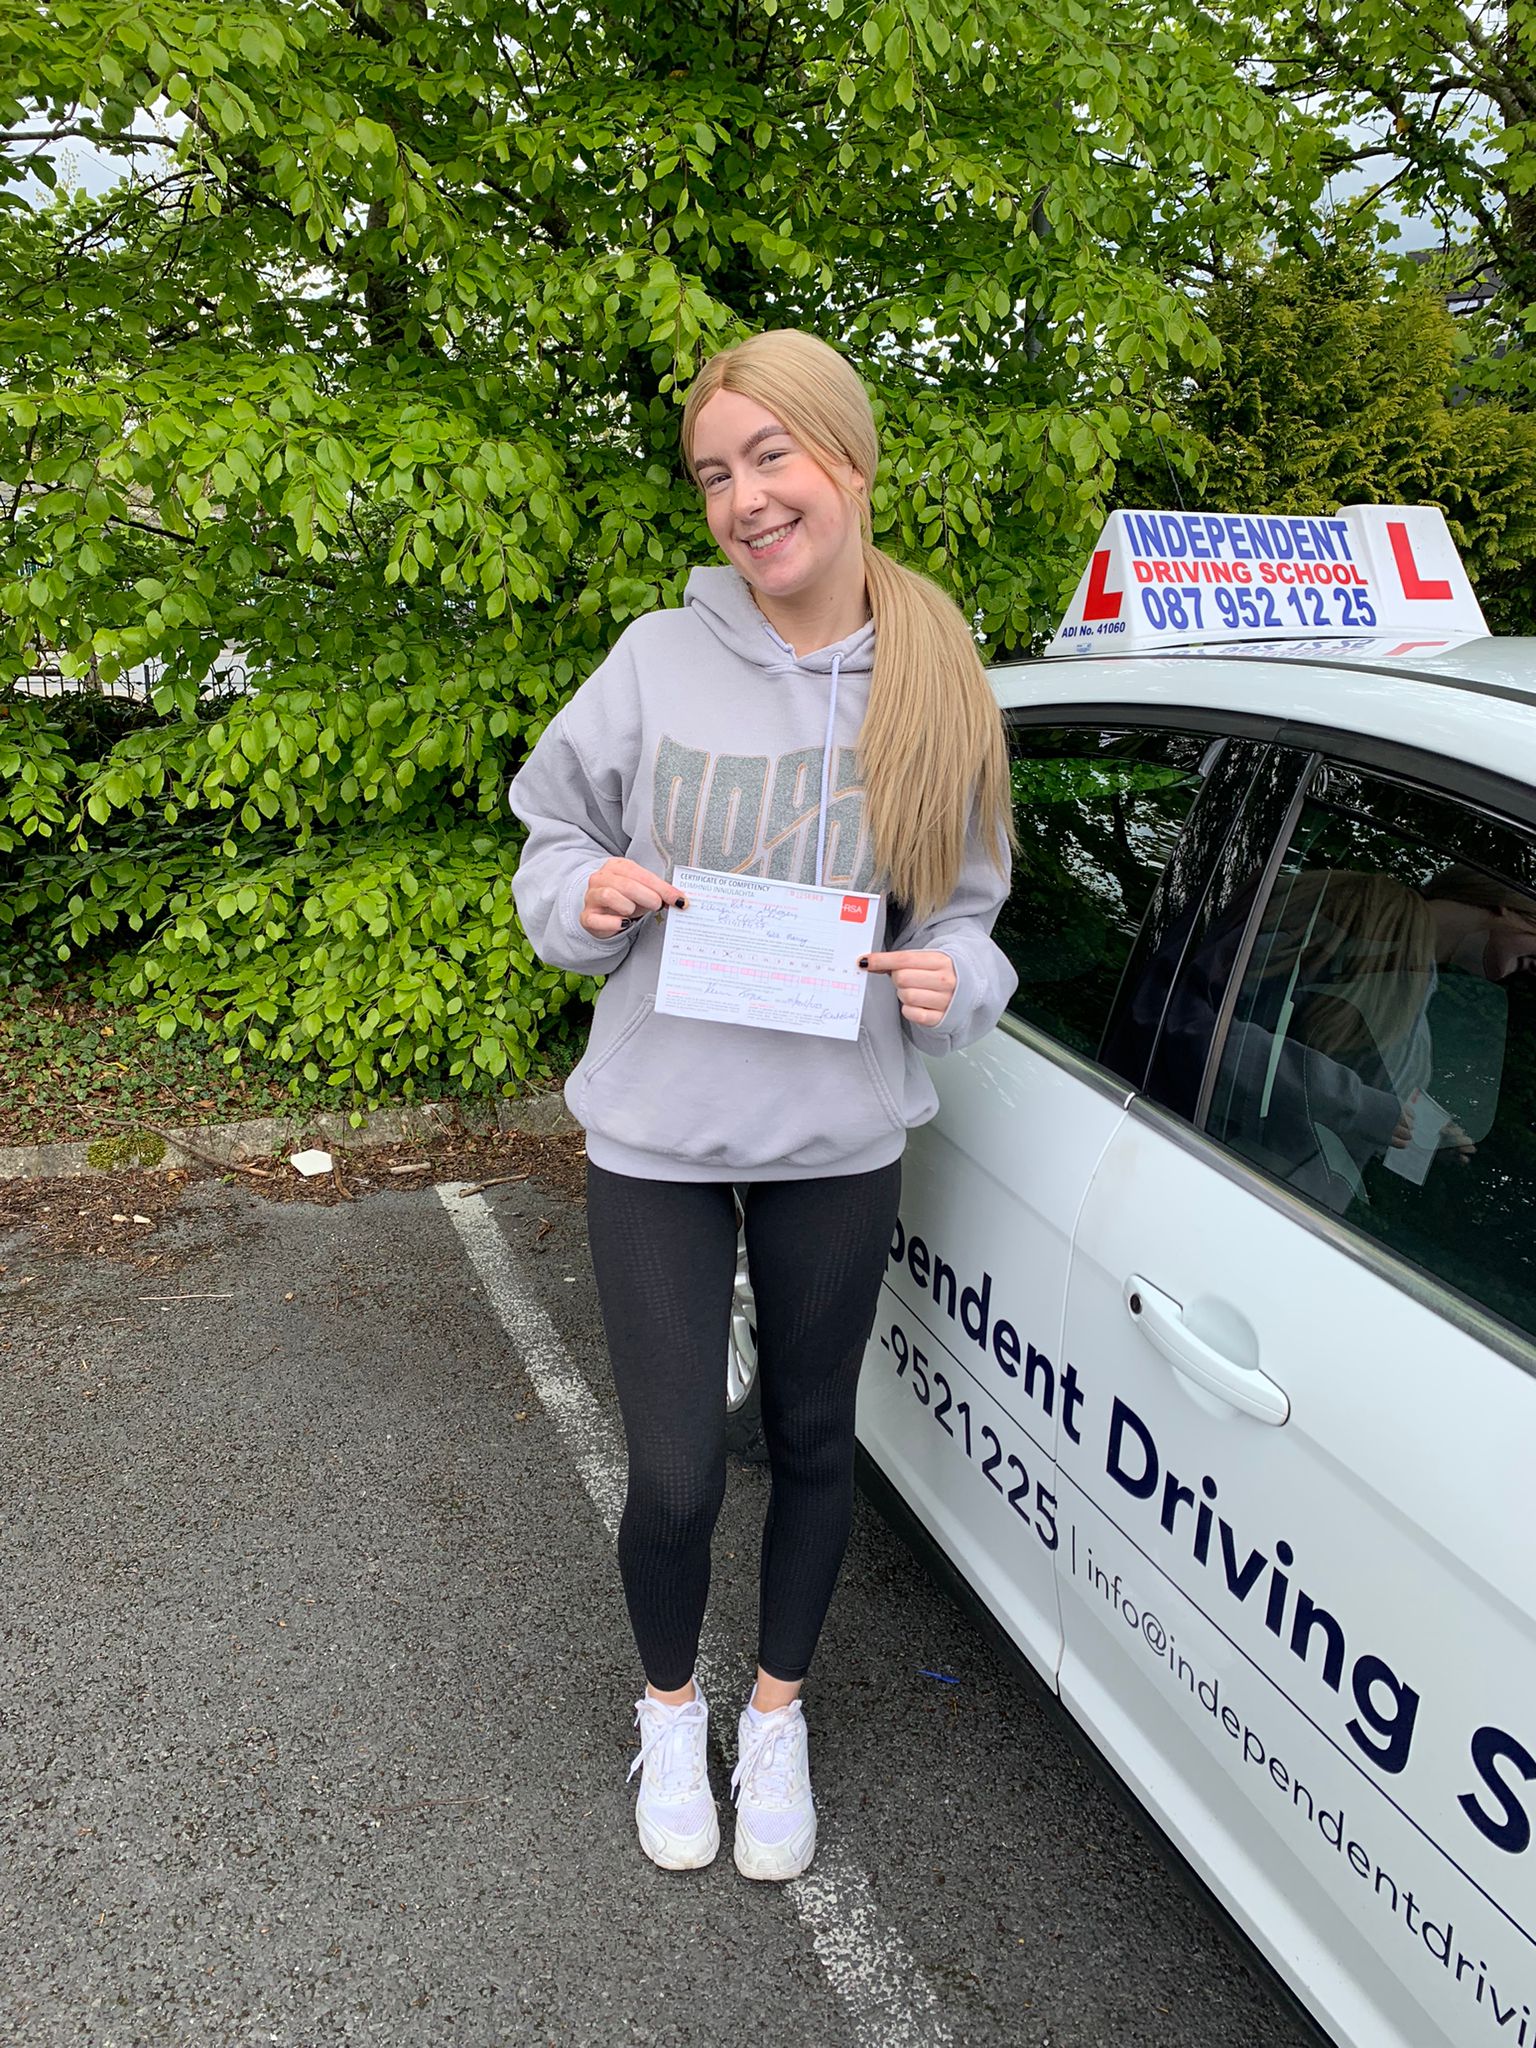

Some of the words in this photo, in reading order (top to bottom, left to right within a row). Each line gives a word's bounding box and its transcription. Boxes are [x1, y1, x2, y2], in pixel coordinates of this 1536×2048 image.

[1122, 514, 1353, 561] INDEPENDENT
[1386, 522, 1453, 600] L
[1082, 550, 1123, 621] L
[1132, 561, 1252, 584] DRIVING
[1261, 562, 1368, 585] SCHOOL
[1061, 626, 1078, 638] ADI
[1079, 625, 1094, 637] No.
[1097, 621, 1126, 635] 41060
[1142, 587, 1203, 630] 087
[1215, 587, 1282, 629] 952
[1287, 587, 1332, 627] 12
[1335, 588, 1377, 627] 25
[680, 873, 717, 885] CERTIFICATE
[719, 877, 727, 886] OF
[729, 879, 770, 892] COMPETENCY
[1106, 1396, 1420, 1774] Driving
[1087, 1549, 1536, 2048] info@independentdrivi
